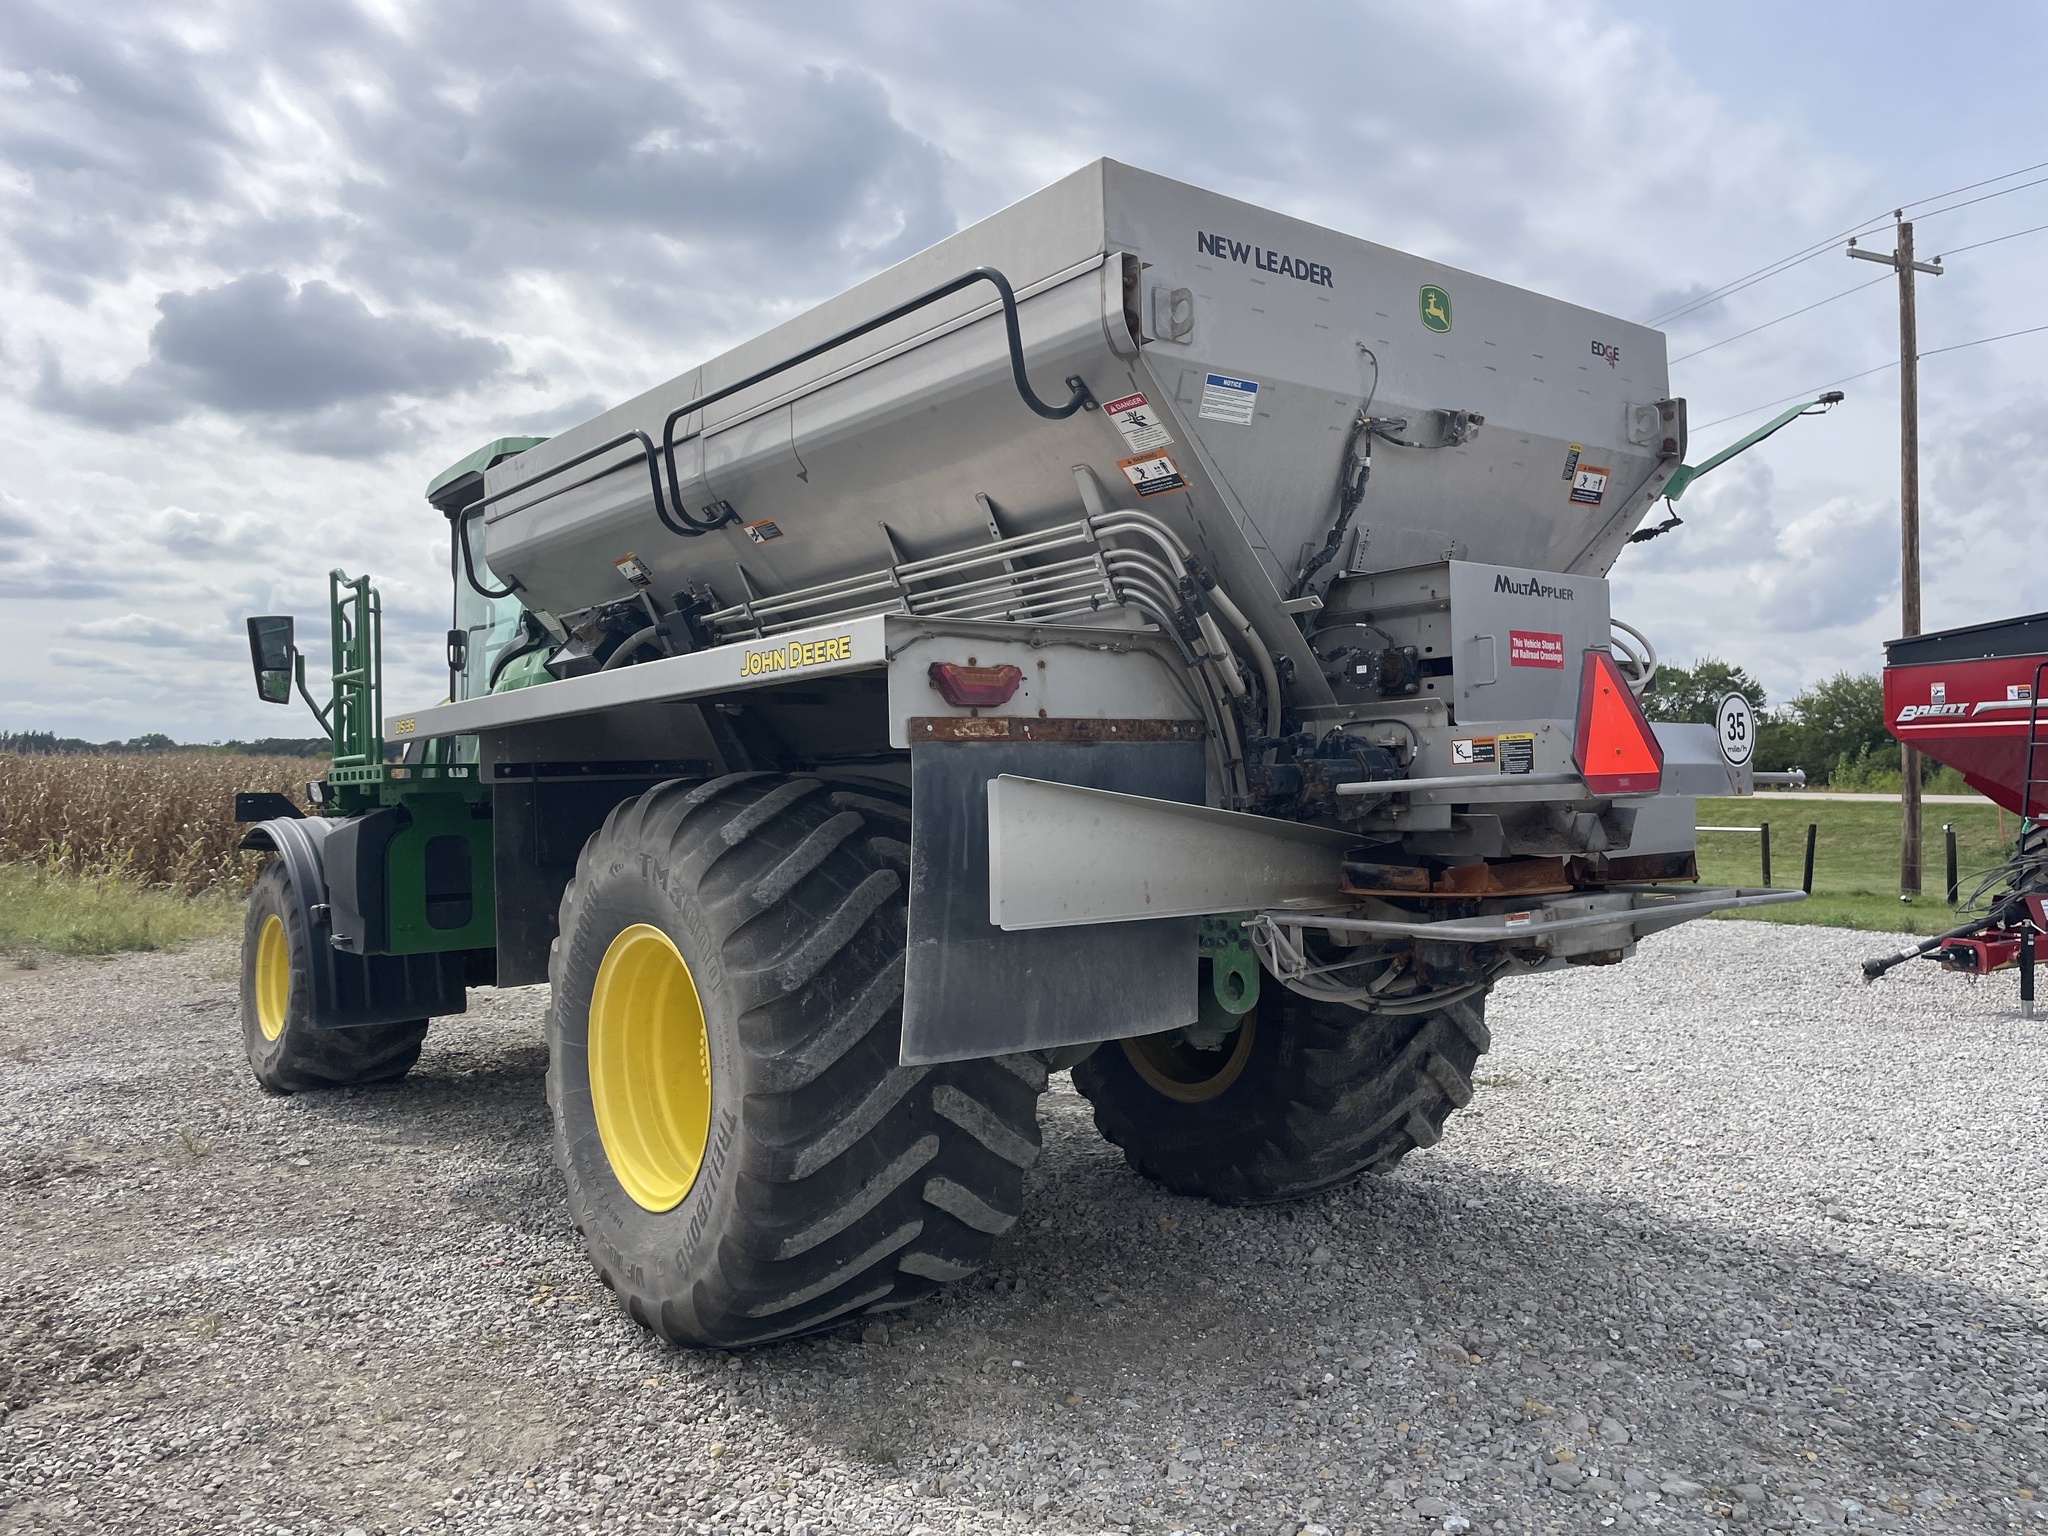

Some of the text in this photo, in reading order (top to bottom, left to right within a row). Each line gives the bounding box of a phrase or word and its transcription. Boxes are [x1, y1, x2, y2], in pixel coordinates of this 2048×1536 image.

[1197, 230, 1334, 289] NEW LEADER
[1591, 340, 1620, 362] EDGE
[1223, 379, 1242, 389] NOTICE
[1115, 397, 1142, 411] DANGER
[1512, 638, 1523, 648] This
[1523, 638, 1541, 649] Vehicle
[1541, 640, 1555, 651] Stops
[741, 635, 851, 677] JOHN DEERE
[1520, 649, 1540, 660] Railroad
[1540, 651, 1563, 663] Crossings
[1896, 703, 1970, 722] BRENT
[1727, 712, 1745, 741] 35
[675, 1107, 738, 1279] TRELLEBORG
